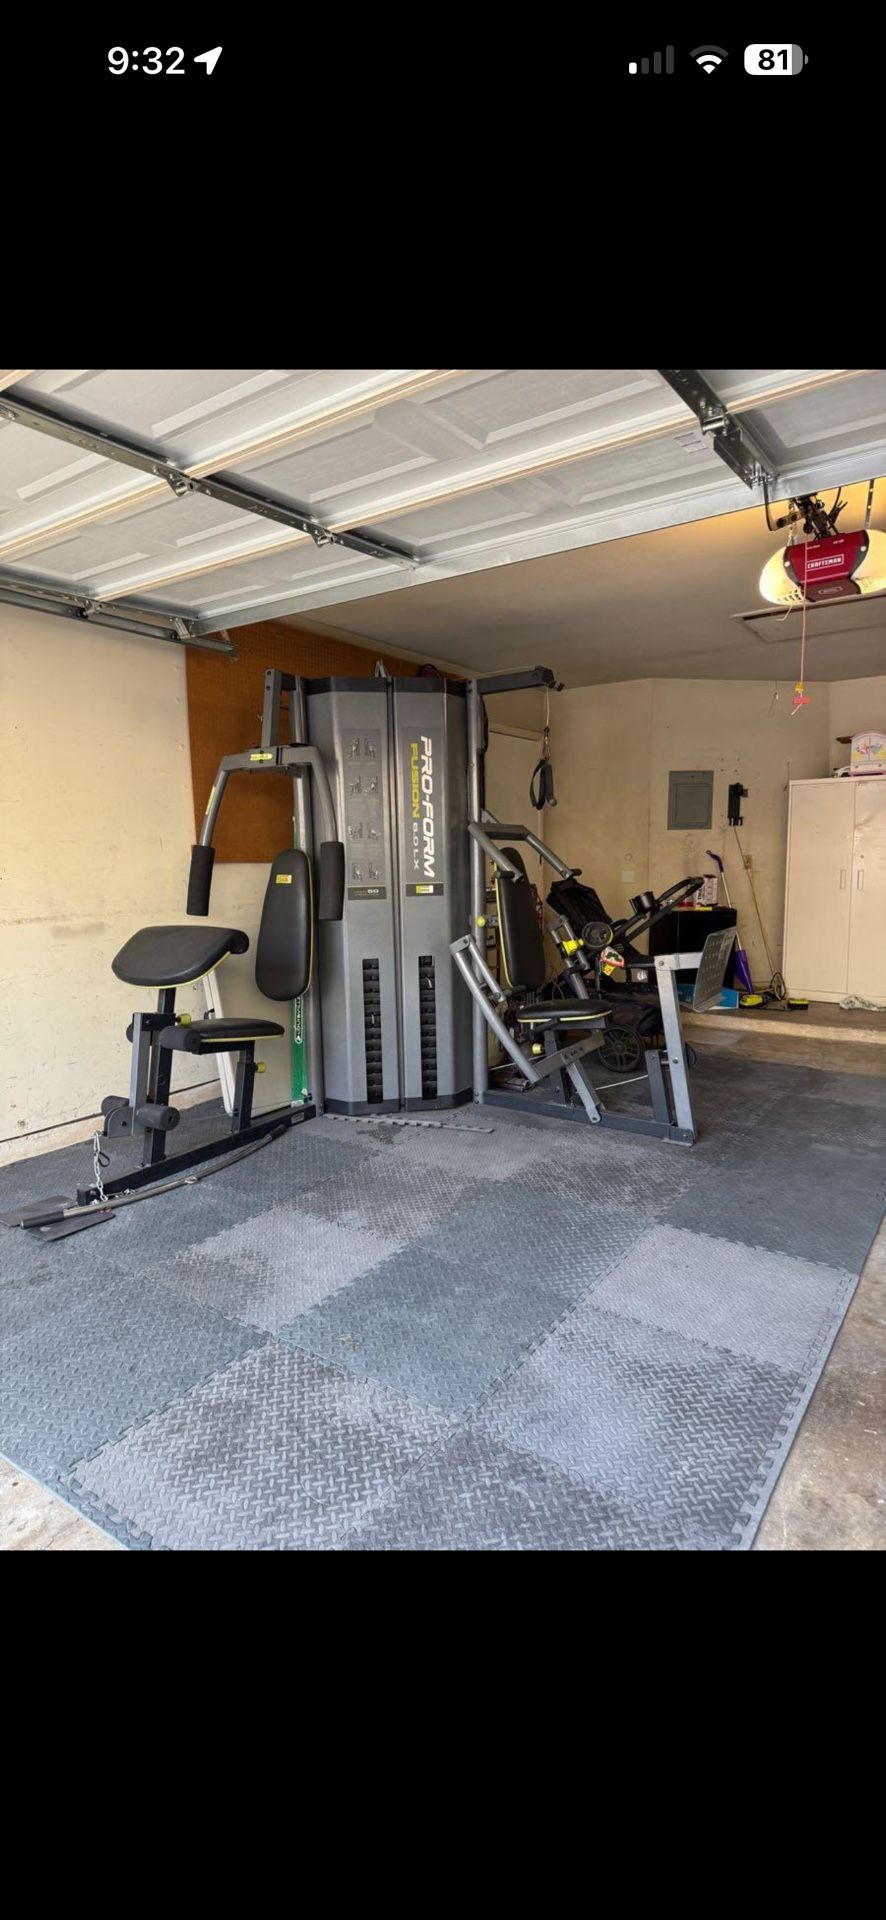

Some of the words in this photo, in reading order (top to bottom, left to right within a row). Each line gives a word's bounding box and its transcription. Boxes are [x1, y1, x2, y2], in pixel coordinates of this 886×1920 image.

[807, 557, 842, 569] CRAFTSMAN
[410, 743, 420, 818] FUSION
[420, 735, 436, 878] PRO-FORM
